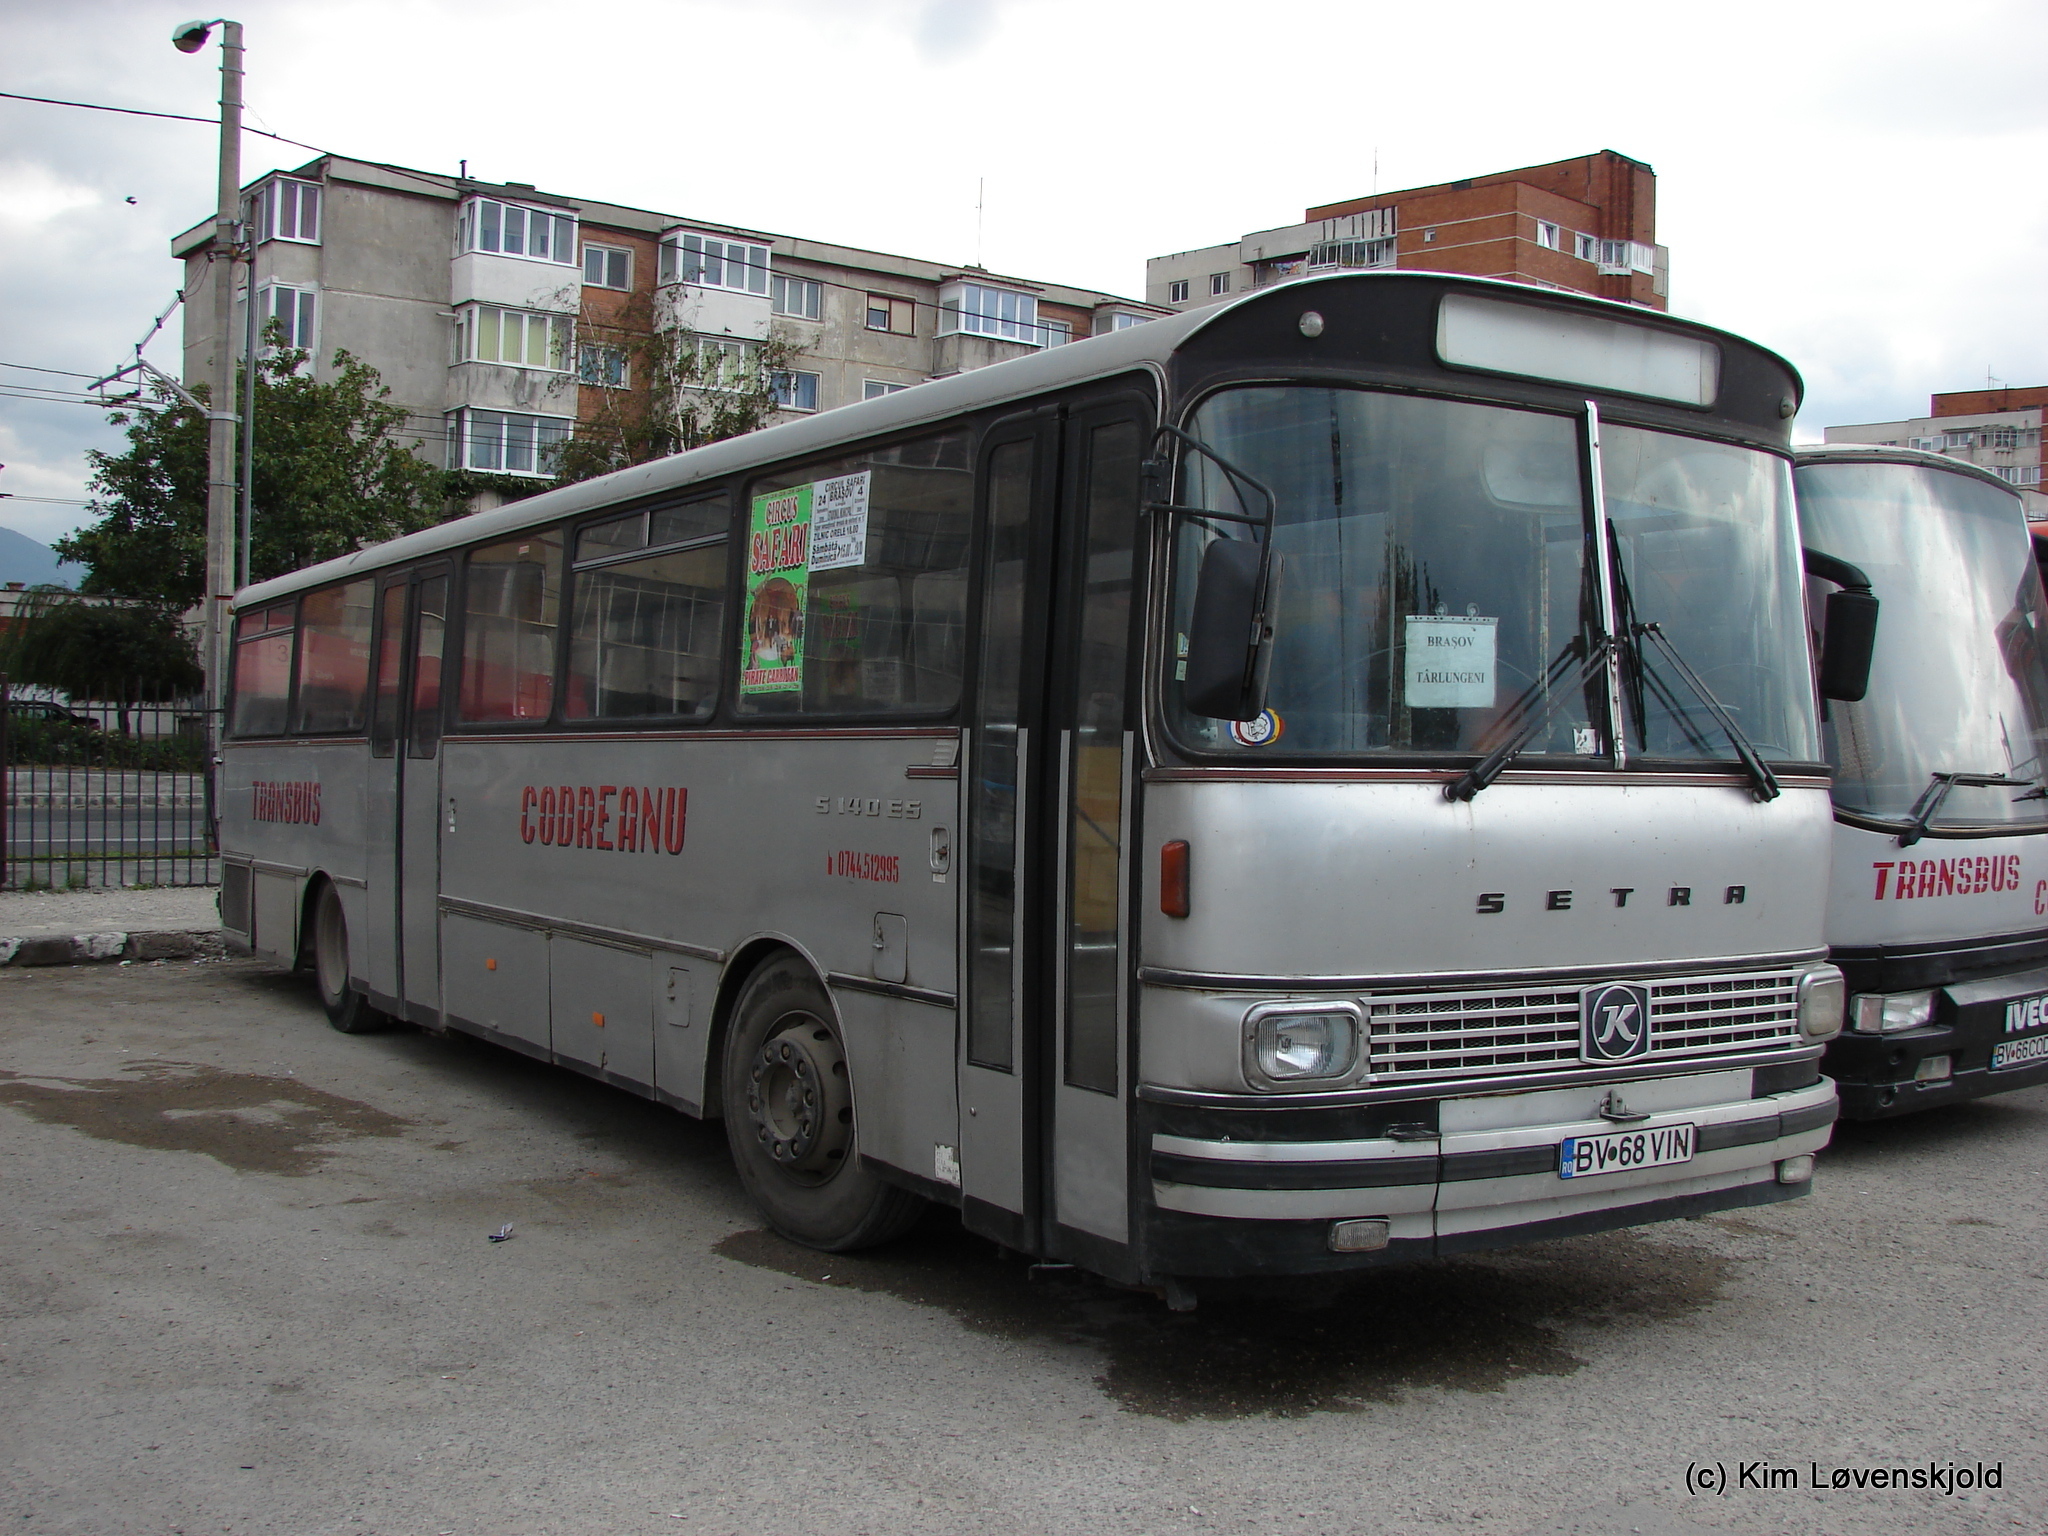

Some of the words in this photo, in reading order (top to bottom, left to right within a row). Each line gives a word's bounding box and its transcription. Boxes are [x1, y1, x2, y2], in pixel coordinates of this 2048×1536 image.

[818, 494, 826, 506] 24
[857, 486, 864, 496] 4
[765, 495, 799, 526] CIRCUS
[751, 522, 809, 575] SAFARI
[744, 669, 767, 686] PIRATE
[1416, 668, 1485, 684] TÂRLUNGENI
[252, 781, 321, 827] TRANSBUS
[887, 799, 922, 819] ES
[521, 786, 688, 856] CODREANU
[838, 850, 899, 883] 0744.512995
[1873, 854, 2020, 901] TRANSBUS
[1476, 884, 1746, 914] SETRA
[1651, 1127, 1689, 1161] VIN
